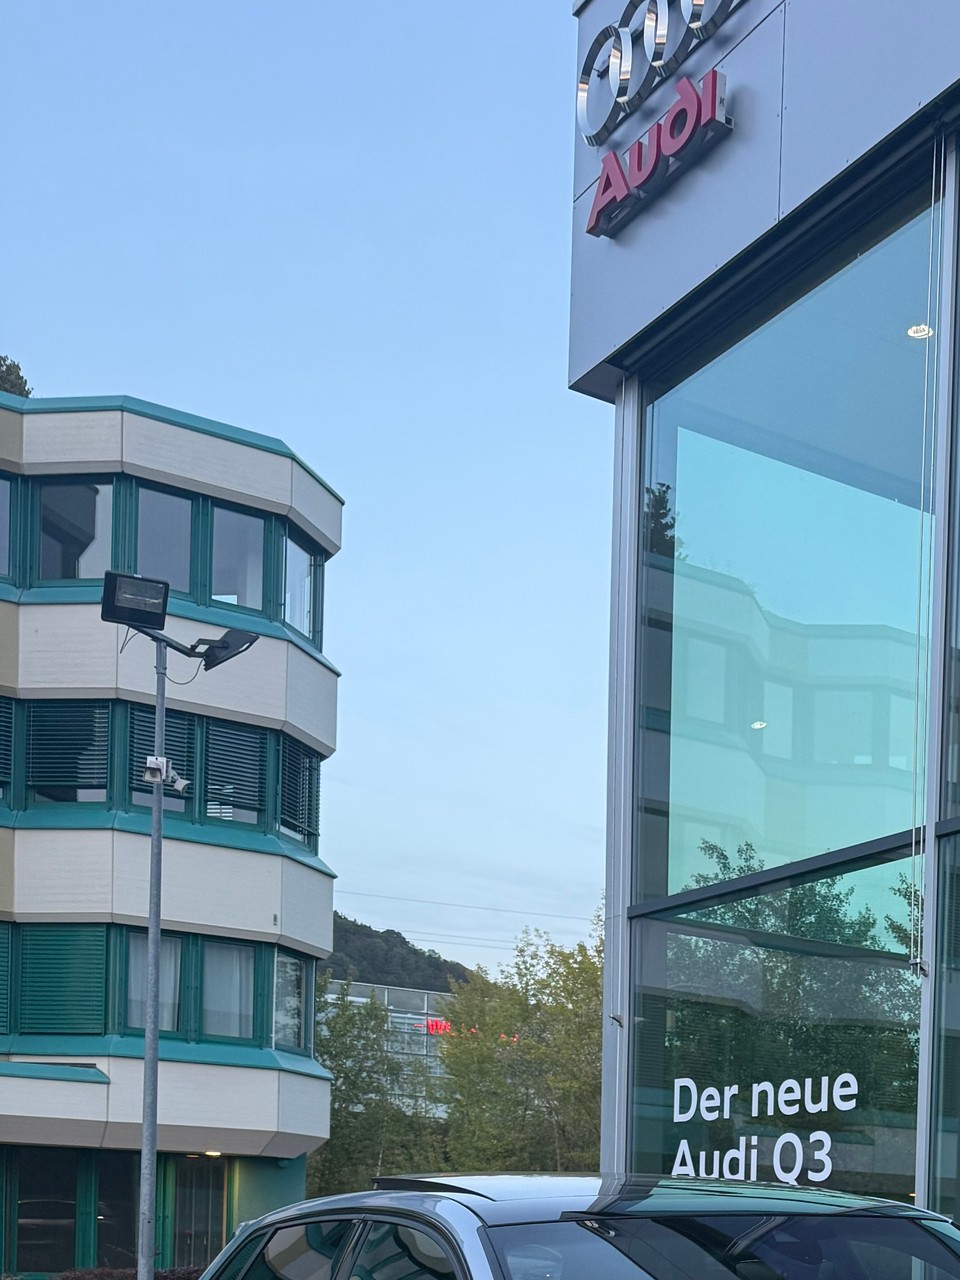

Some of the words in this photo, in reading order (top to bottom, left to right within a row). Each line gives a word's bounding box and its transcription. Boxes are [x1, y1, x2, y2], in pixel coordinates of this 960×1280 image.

[586, 68, 718, 234] Audi
[673, 1077, 739, 1123] Der
[751, 1072, 859, 1117] neue
[671, 1135, 758, 1182] Audi
[773, 1131, 833, 1186] Q3
